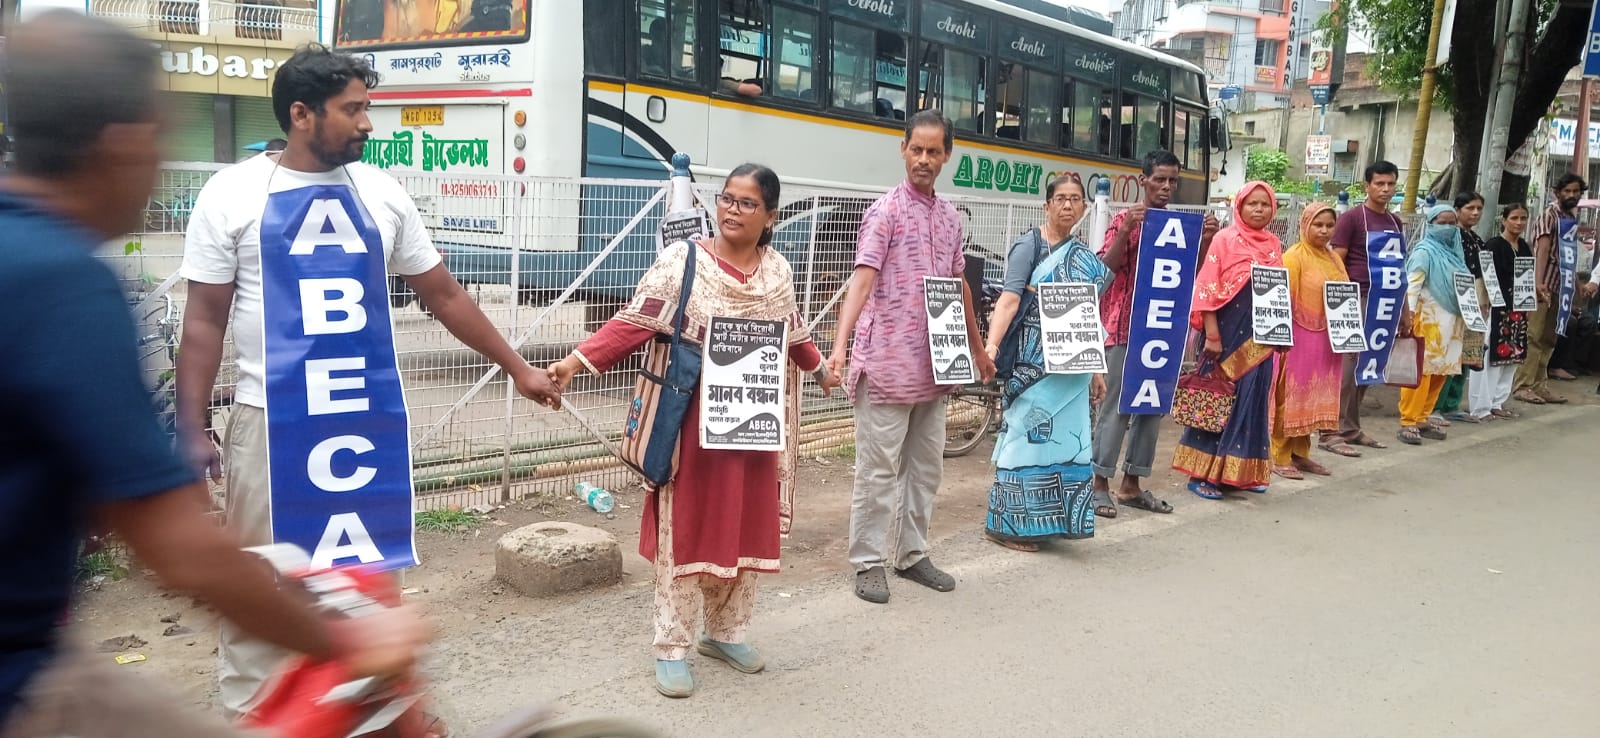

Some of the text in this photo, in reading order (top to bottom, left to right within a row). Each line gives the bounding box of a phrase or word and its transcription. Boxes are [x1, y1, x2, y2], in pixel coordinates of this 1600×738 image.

[937, 17, 976, 39] Arohi
[1012, 38, 1046, 57] Arohi
[390, 52, 442, 73] রামপুরহাট
[458, 49, 511, 71] মুরারই
[1075, 55, 1104, 71] Arohi
[1133, 70, 1159, 87] Arohi
[422, 131, 488, 171] ট্রাভেলস
[953, 154, 1043, 194] AROHI
[443, 217, 497, 229] SAVE LIFE
[1558, 224, 1578, 335] ABECA
[1081, 306, 1094, 314] ২৩
[1130, 218, 1187, 407] ABECA
[1362, 238, 1403, 380] ABECA
[1046, 331, 1072, 343] মানব
[761, 351, 778, 362] ২৩
[1080, 353, 1100, 361] ABECA
[288, 199, 384, 571] ABECA
[742, 373, 779, 385] সারা বাংলা
[708, 384, 779, 405] মানব বন্ধন
[749, 420, 777, 430] ABECA
